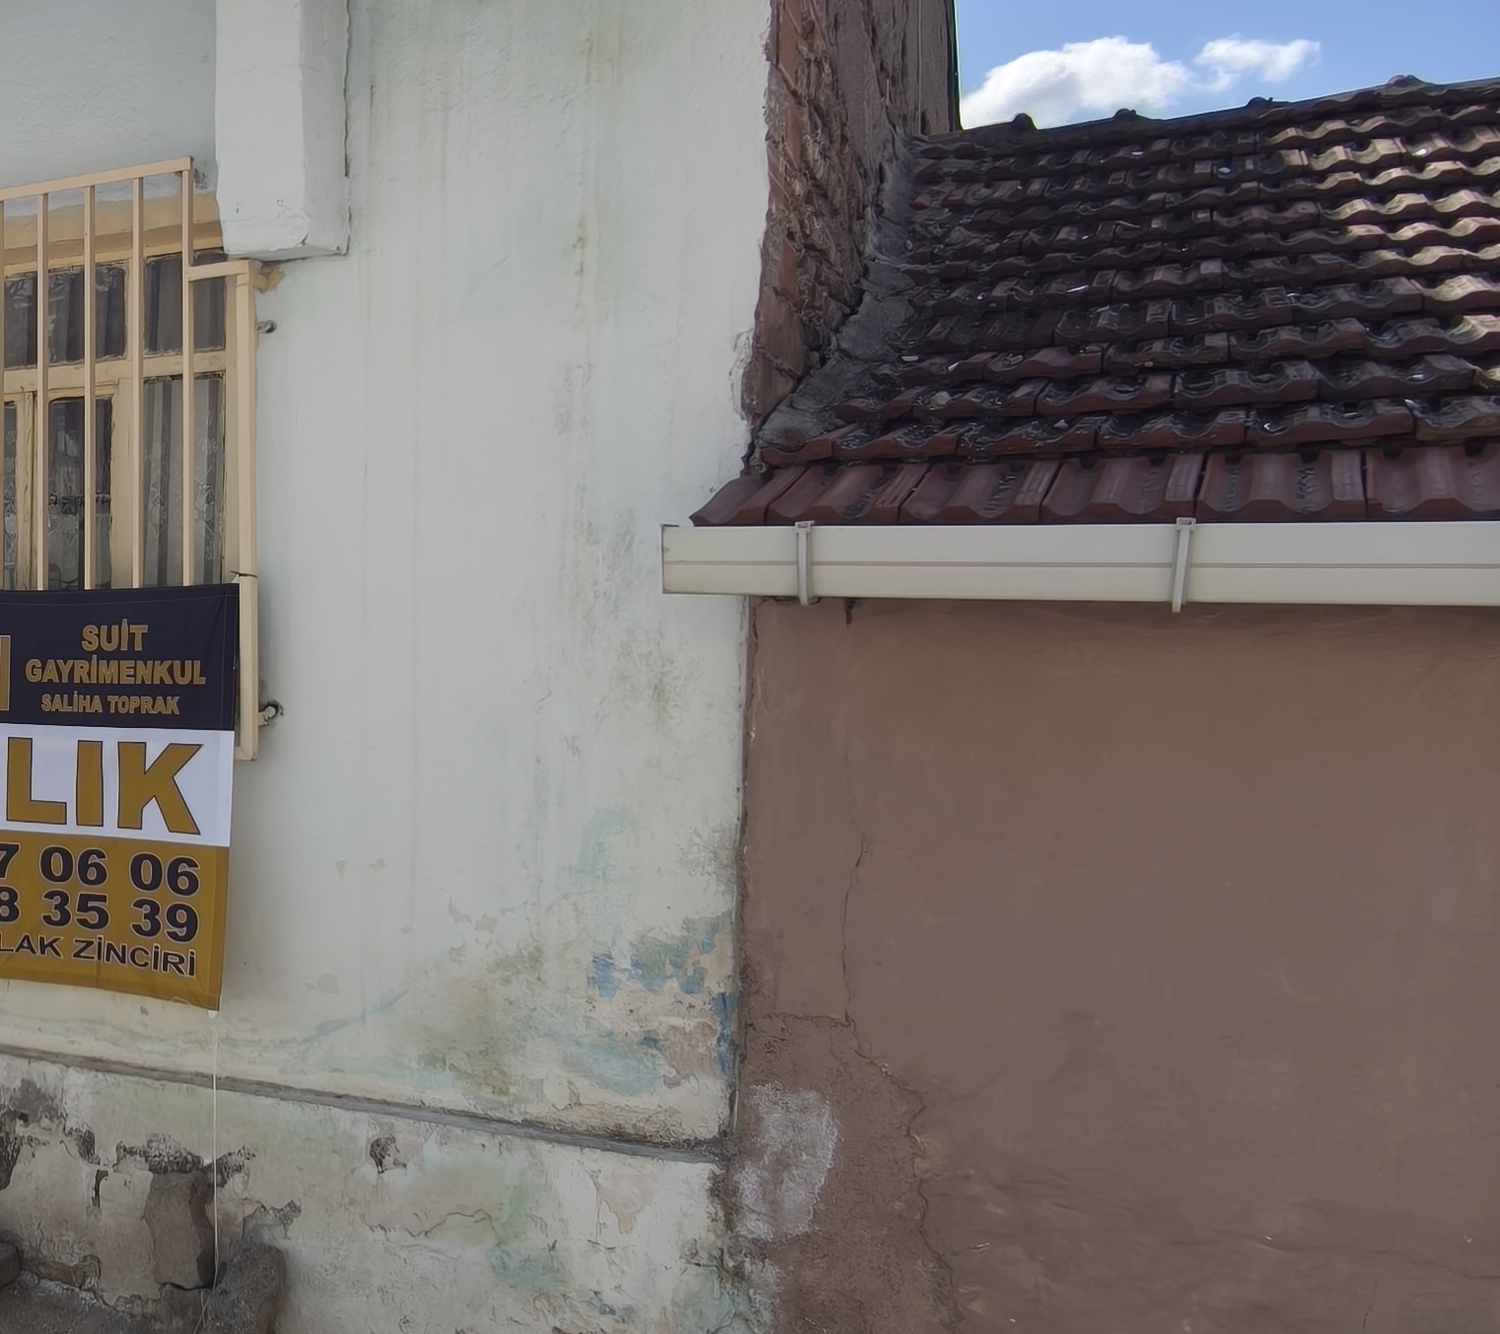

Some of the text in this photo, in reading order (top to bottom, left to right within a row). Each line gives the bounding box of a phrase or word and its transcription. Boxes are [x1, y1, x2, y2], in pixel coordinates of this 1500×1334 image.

[81, 618, 148, 651] SUİT
[25, 654, 206, 685] GAYRİMENKUL
[41, 690, 180, 715] SALİHA TOPRAK
[39, 845, 108, 886] 06
[129, 851, 200, 897] 06
[41, 889, 110, 930] 35
[130, 897, 199, 943] 39
[71, 934, 196, 978] ZİNCİRİ
